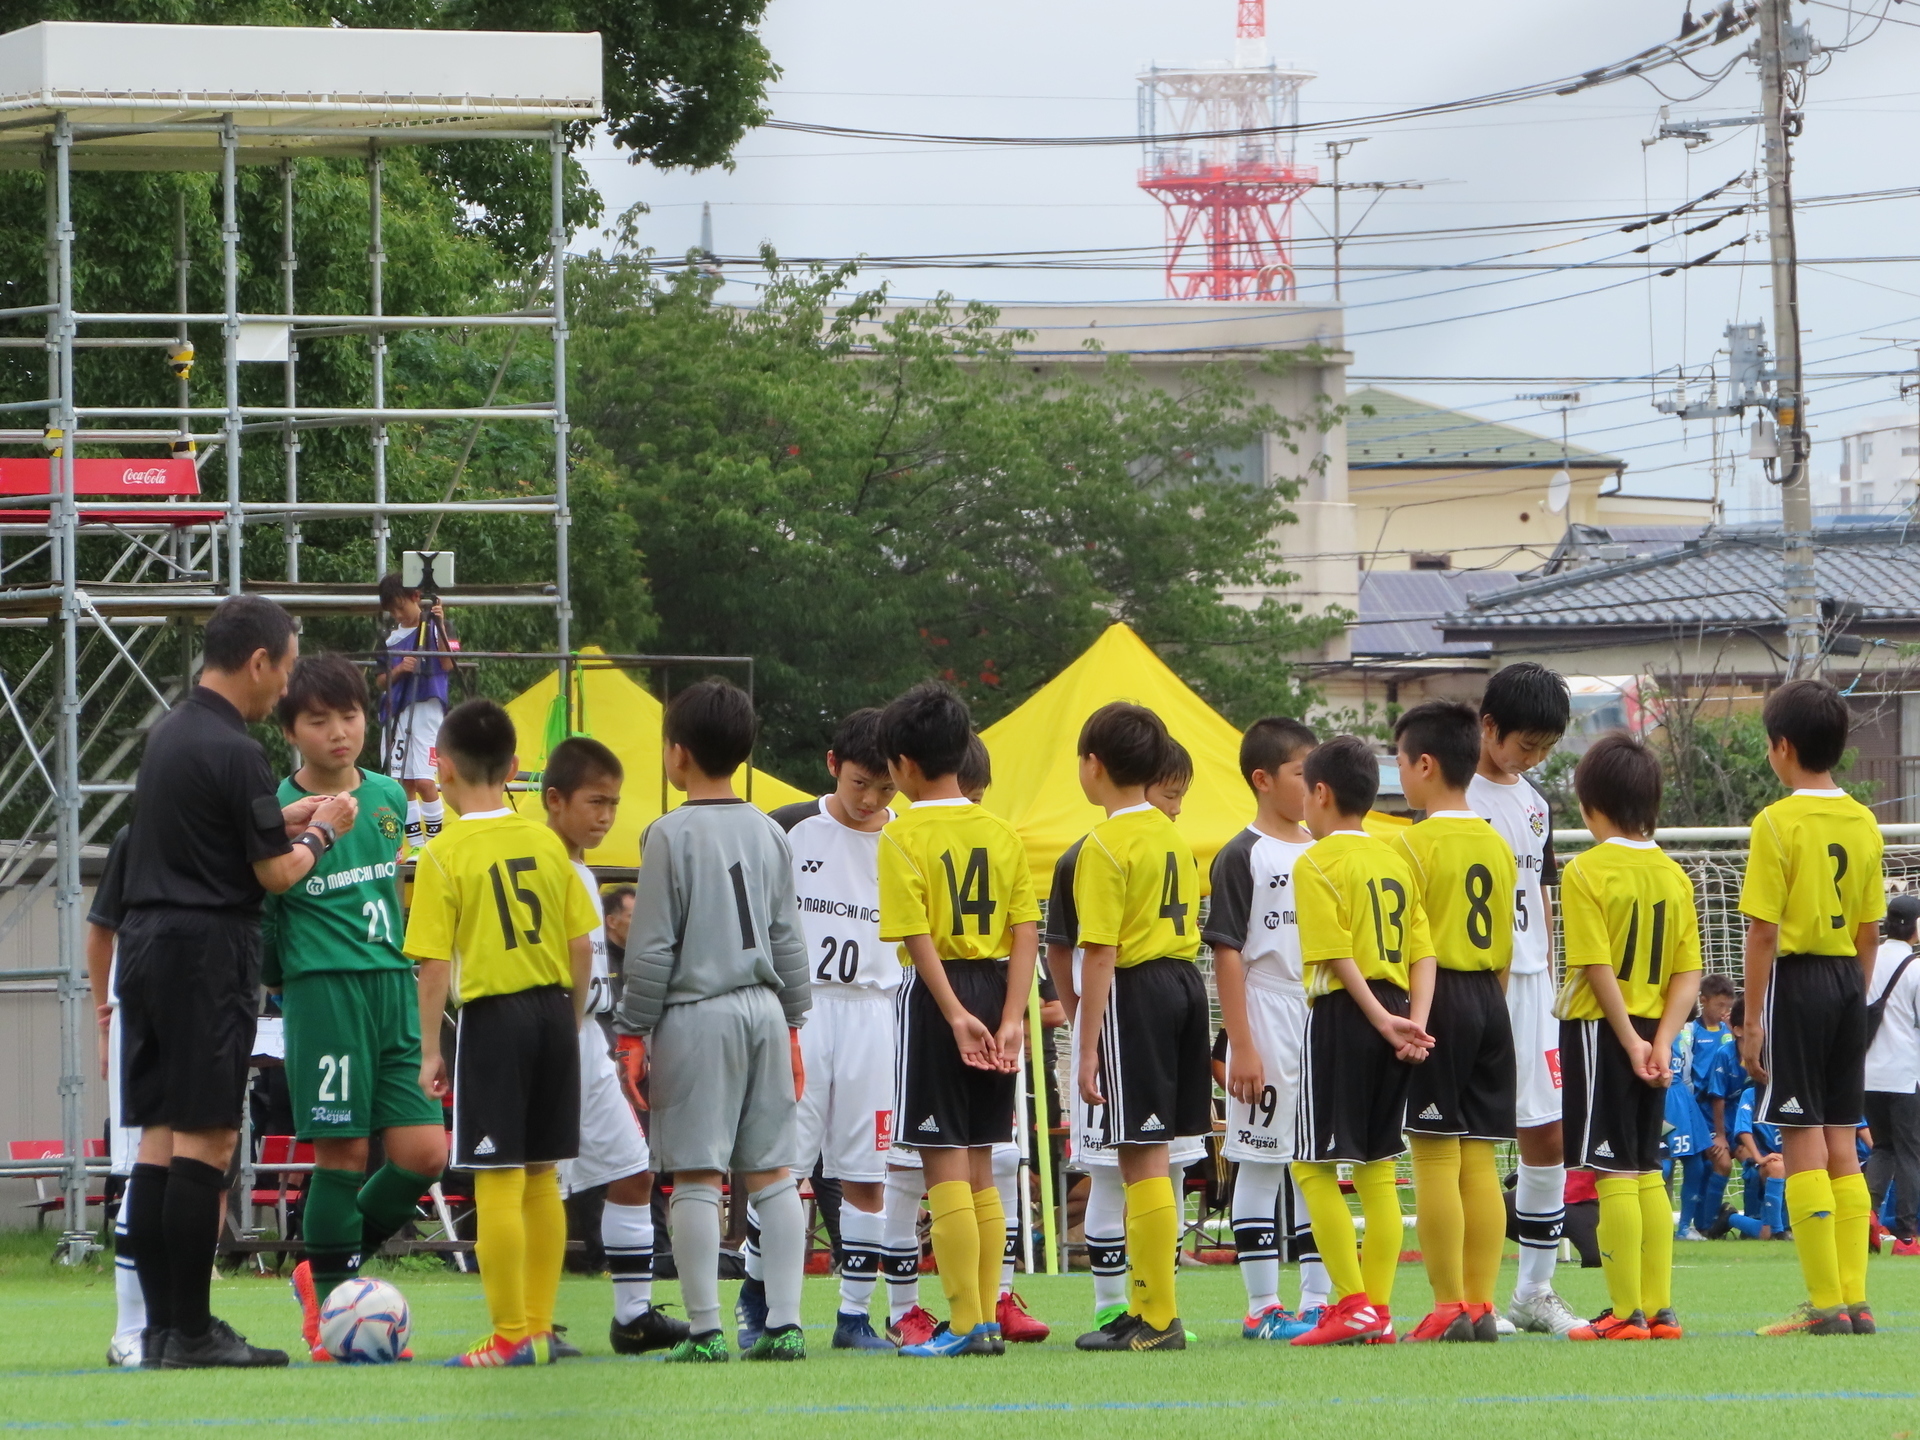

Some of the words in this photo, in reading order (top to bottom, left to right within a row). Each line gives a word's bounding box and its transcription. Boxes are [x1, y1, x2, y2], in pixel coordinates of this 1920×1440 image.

[122, 468, 167, 484] Coca-Cola
[327, 866, 373, 890] MABUCHI
[940, 847, 997, 936] 14
[1159, 851, 1188, 936] 4
[1827, 842, 1849, 930] 3
[363, 898, 393, 943] 21
[488, 856, 542, 951] 15
[728, 861, 756, 950] 1
[804, 897, 858, 919] MABUCHI
[1282, 910, 1298, 924] MA
[1366, 877, 1407, 963] 13
[1465, 863, 1493, 949] 8
[1616, 898, 1666, 985] 11
[817, 935, 859, 983] 20
[318, 1054, 349, 1102] 21
[311, 1106, 352, 1124] Reysol
[1779, 1105, 1804, 1115] adidas
[1140, 1124, 1165, 1132] adidas
[1238, 1129, 1279, 1149] Reysol
[1673, 1135, 1691, 1154] 35
[473, 1147, 496, 1155] adidas
[1594, 1149, 1615, 1158] adidas
